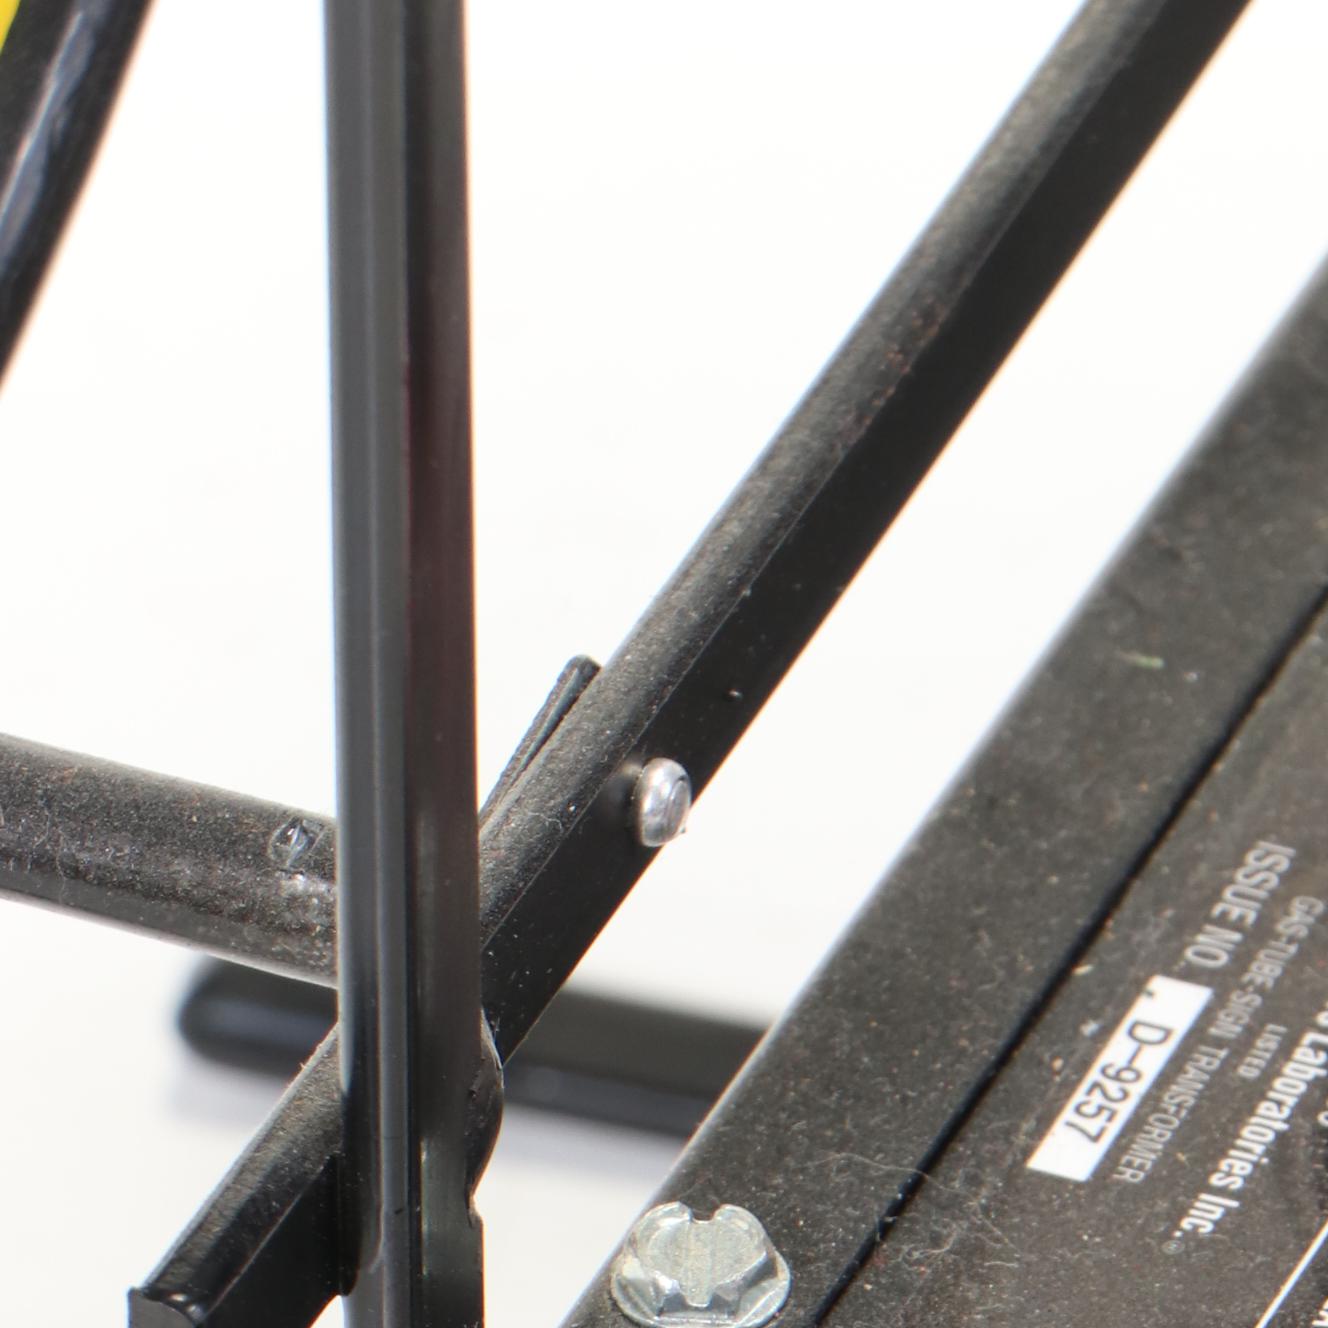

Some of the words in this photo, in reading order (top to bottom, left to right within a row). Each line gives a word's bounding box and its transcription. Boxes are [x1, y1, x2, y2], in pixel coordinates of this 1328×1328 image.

[1206, 840, 1299, 926] ISSUE
[1058, 1019, 1174, 1144] D-9257
[1234, 1023, 1288, 1079] LISTED
[1109, 1043, 1229, 1184] TRANSFORMER
